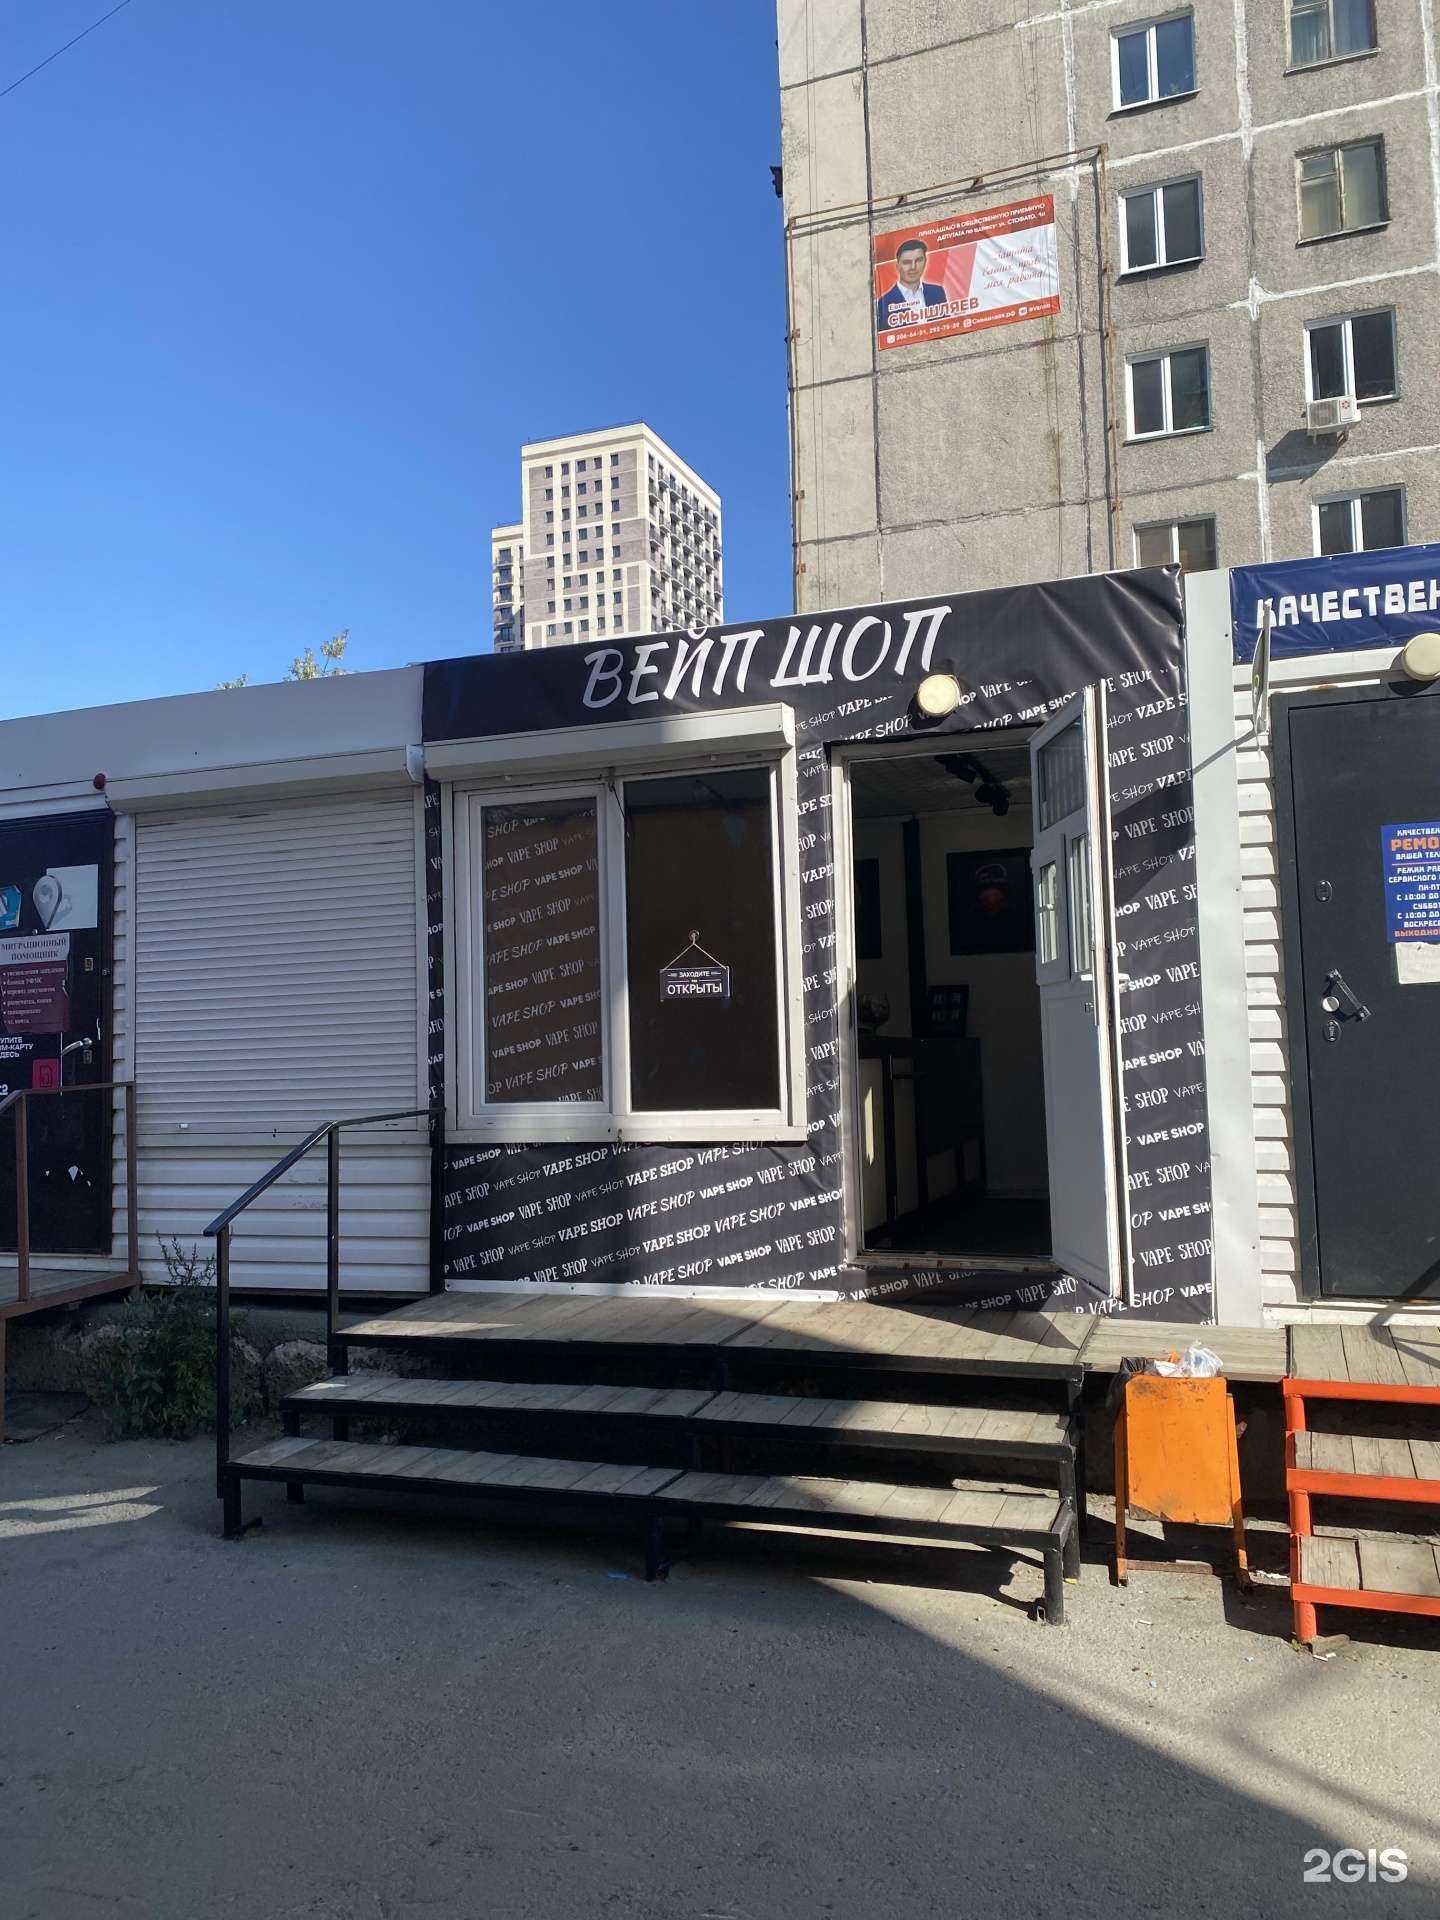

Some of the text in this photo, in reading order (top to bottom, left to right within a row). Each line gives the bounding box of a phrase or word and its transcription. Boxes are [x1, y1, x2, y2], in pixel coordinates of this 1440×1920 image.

[888, 297, 979, 327] СМЫШЛЯЕВ
[582, 606, 952, 708] ВЕЙП ШОП
[809, 711, 836, 727] SHOP
[837, 698, 871, 717] VAPE
[1018, 704, 1047, 721] VAPE
[1136, 697, 1175, 719] VAPE
[875, 714, 913, 738] SHOP
[1141, 735, 1174, 757] SHOP
[1122, 783, 1153, 799] SHOP
[1125, 806, 1194, 838] VAPE SHOP
[507, 838, 559, 864] VAPE SHOP
[1391, 837, 1440, 851] РЕМО
[802, 863, 834, 883] VAPE
[1143, 855, 1175, 870] SHOP
[500, 864, 583, 898] SHOP VAPE SHOP
[1145, 889, 1179, 911] VAPE
[520, 906, 542, 924] VAPE
[547, 926, 595, 947] VAPE SHOP
[1131, 926, 1196, 951] VAPE SHOP
[505, 960, 584, 991] SHOP VAPE SHOP
[667, 982, 723, 994] ОТКРЫТЫ
[1128, 962, 1200, 991] SHOP VAPE
[491, 995, 583, 1028] VAPE SHOP VAPE
[1152, 1008, 1183, 1024] VAPE
[492, 1022, 598, 1059] VAPE SHOP VAPE SHOP
[1149, 1047, 1183, 1065] SHOP
[505, 1057, 597, 1089] VAPE SHOP VAPE
[1135, 1082, 1205, 1109] SHOP VAPE
[1137, 1122, 1204, 1146] VAPE SHOP
[452, 1148, 501, 1170] VAPE SHOP
[465, 1148, 608, 1201] SHOP VAPE SHOP VAPE SHOP
[1156, 1162, 1190, 1183] SHOP
[467, 1145, 730, 1233] VAPE SHOP VAPE SHOP VAPE SHOP VAPE SHOP VAPE
[453, 1156, 816, 1272] VAPE SHOP VAPE SHOP VAPE SHOP VAPE SHOP VAPE SHOP VAPE SHOP
[1158, 1205, 1191, 1221] VAPE
[533, 1196, 818, 1283] VAPE SHOP VAPE SHOP VAPE SHOP VAPE SHOP VAPE
[643, 1225, 836, 1286] VAPE SHOP VAPE SHOP VAPE SHOP
[1140, 1239, 1211, 1267] VAPE SHOP
[768, 1271, 805, 1290] SHOP
[809, 1266, 838, 1281] VAPE
[850, 1286, 879, 1301] VAPE
[881, 1279, 909, 1294] SHOP
[912, 1271, 944, 1288] VAPE
[981, 1294, 1012, 1310] SHOP
[1016, 1283, 1048, 1303] VAPE
[1132, 1283, 1212, 1308] SHOP VAPE
